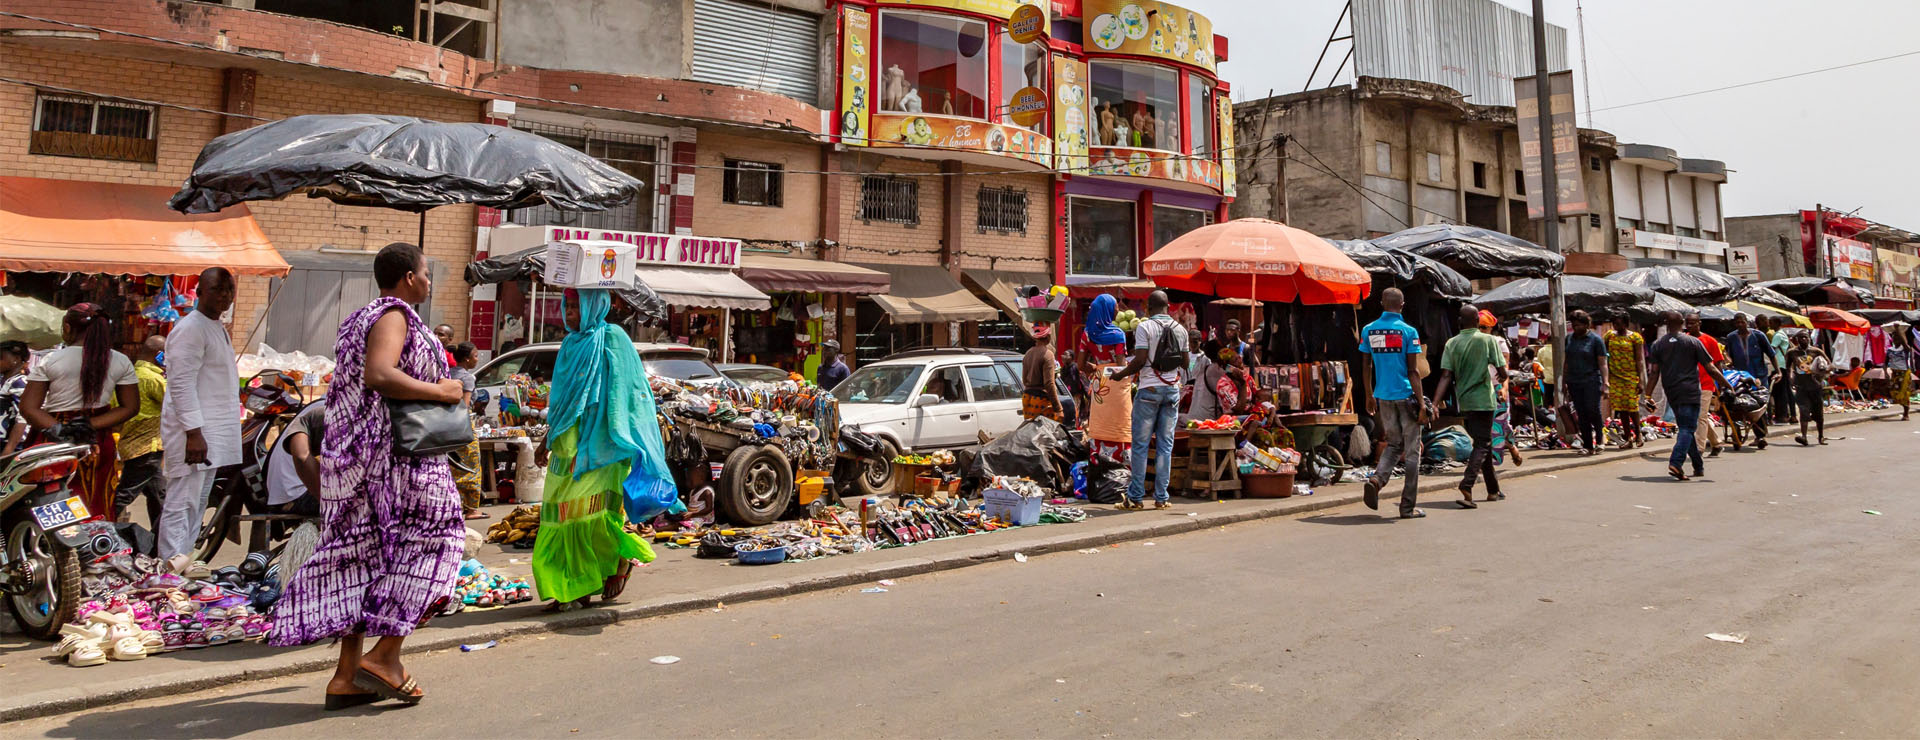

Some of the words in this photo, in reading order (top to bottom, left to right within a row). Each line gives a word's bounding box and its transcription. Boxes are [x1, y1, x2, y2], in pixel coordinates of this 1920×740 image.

[1012, 16, 1038, 29] GALERIE
[955, 125, 972, 138] BB
[604, 233, 669, 262] UTY
[679, 238, 738, 265] SUPPLY
[1151, 261, 1170, 272] Kash
[1173, 260, 1193, 271] Kash
[1218, 260, 1249, 270] Kash
[1255, 261, 1286, 272] Kash
[41, 510, 75, 527] 5402
